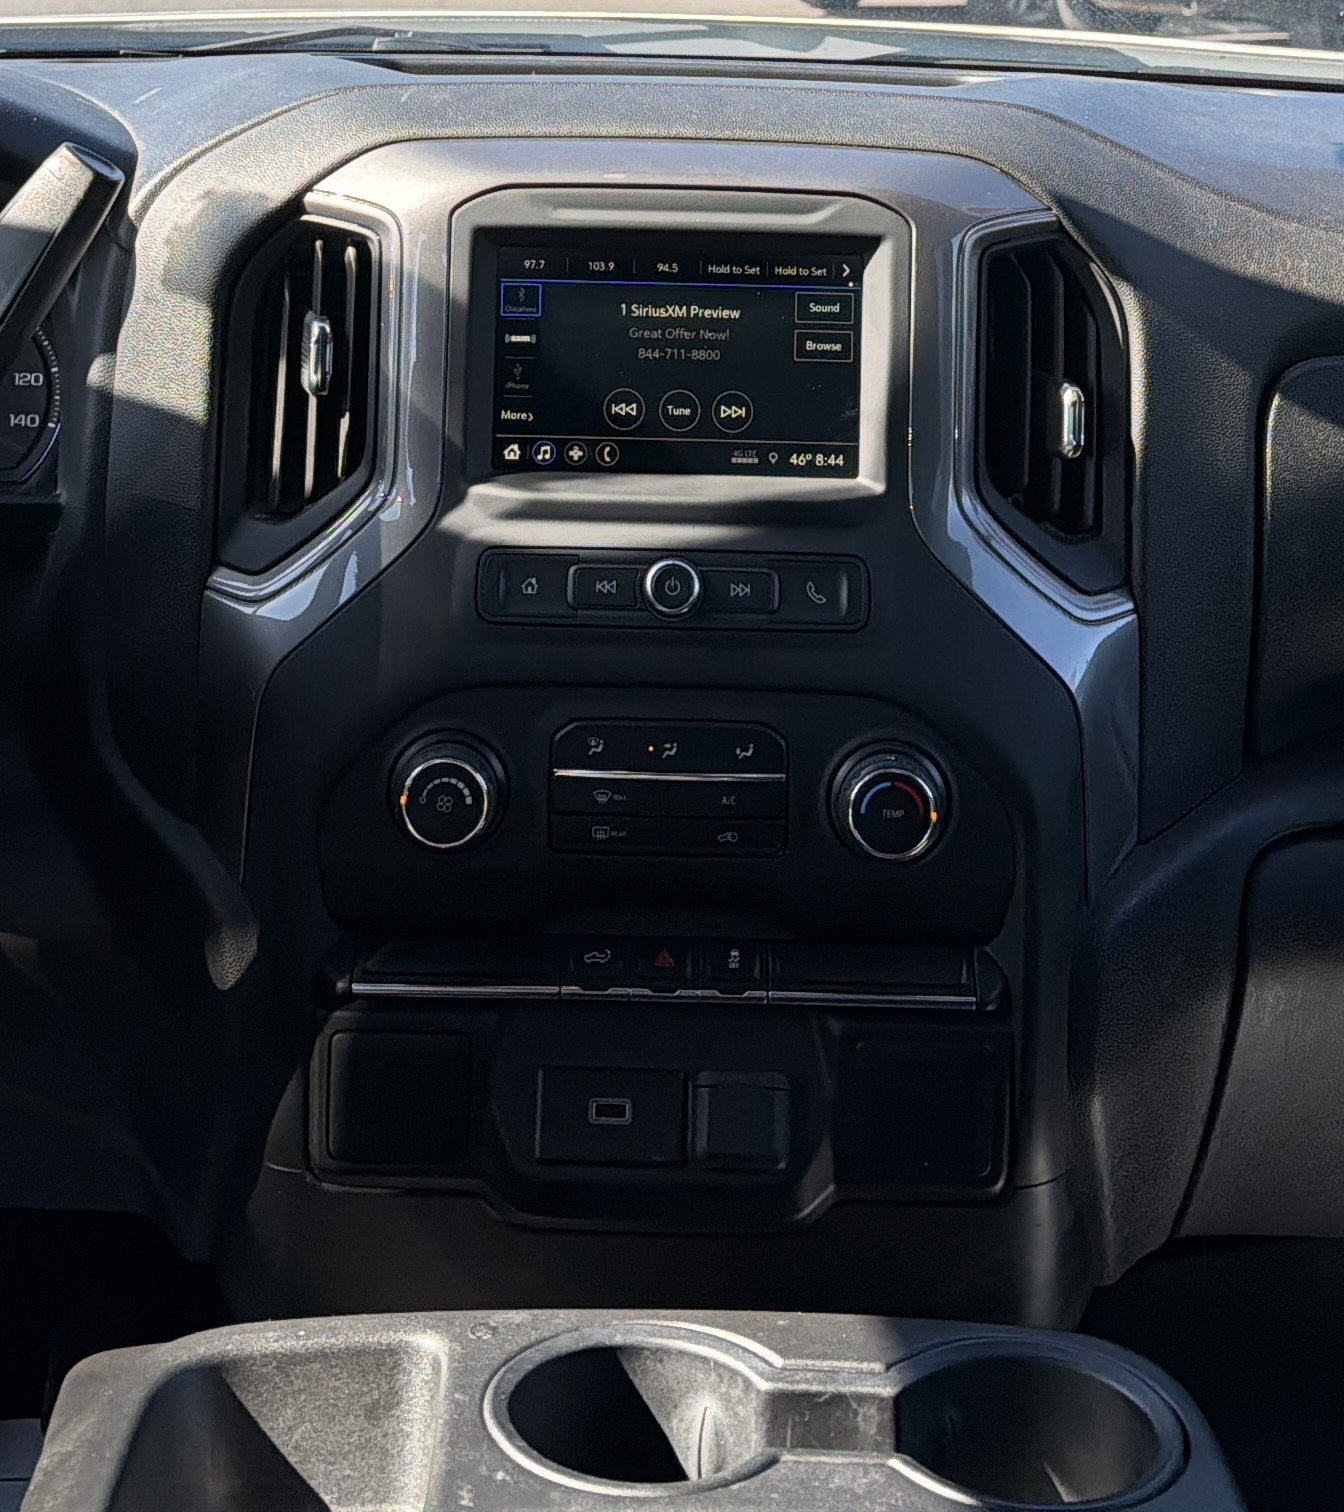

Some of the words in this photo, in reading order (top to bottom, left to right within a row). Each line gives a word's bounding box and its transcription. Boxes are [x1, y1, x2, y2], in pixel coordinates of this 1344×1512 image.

[523, 259, 546, 270] 97.7
[588, 261, 615, 272] 103.9
[656, 263, 678, 273] 94.5
[708, 264, 730, 274] Hold
[732, 266, 742, 275] to
[744, 265, 761, 276] Set
[774, 266, 796, 276] Hold
[798, 268, 809, 277] to
[810, 267, 828, 278] Set
[620, 304, 626, 316] 1
[630, 304, 687, 318] SiriusXM
[690, 306, 741, 320] Preview
[809, 302, 840, 313] Sound
[628, 327, 662, 339] Great
[665, 328, 697, 340] Offer
[699, 328, 730, 341] Now!
[806, 340, 842, 352] Browse
[638, 348, 720, 361] 844-711-8800
[13, 372, 44, 386] 120
[500, 410, 528, 420] More
[666, 405, 692, 416] Tune
[9, 414, 40, 428] 140
[732, 450, 744, 458] 4G
[744, 450, 757, 458] LTE
[815, 454, 845, 467] 8:44
[721, 796, 737, 806] A/C
[882, 809, 904, 820] TEMP
